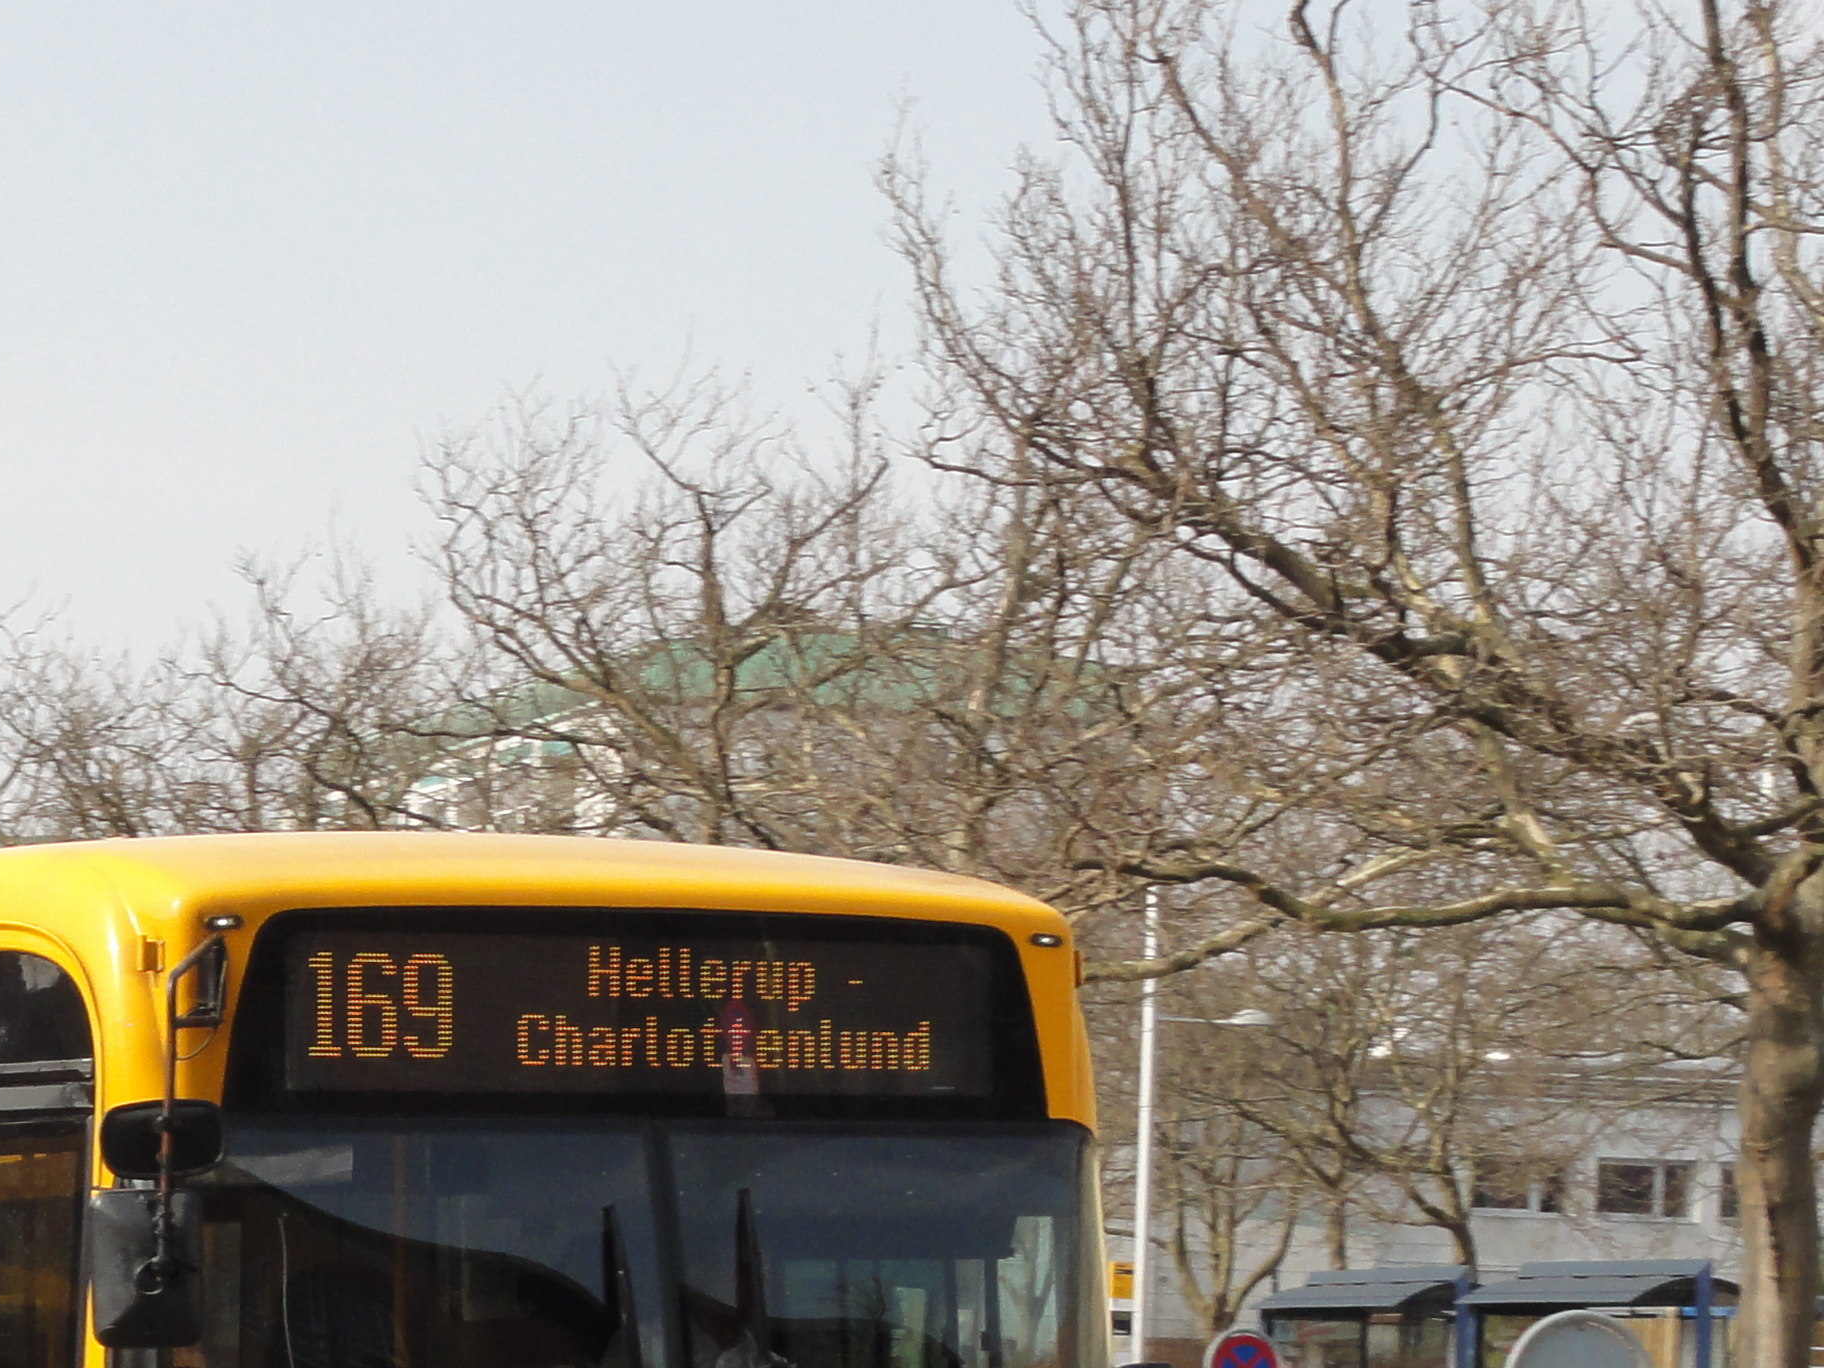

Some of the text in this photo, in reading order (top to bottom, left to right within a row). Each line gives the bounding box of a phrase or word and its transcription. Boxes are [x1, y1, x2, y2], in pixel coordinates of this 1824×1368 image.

[307, 950, 455, 1059] 169
[587, 945, 817, 1012] Hellerup
[516, 1013, 932, 1072] Charlottenlund
